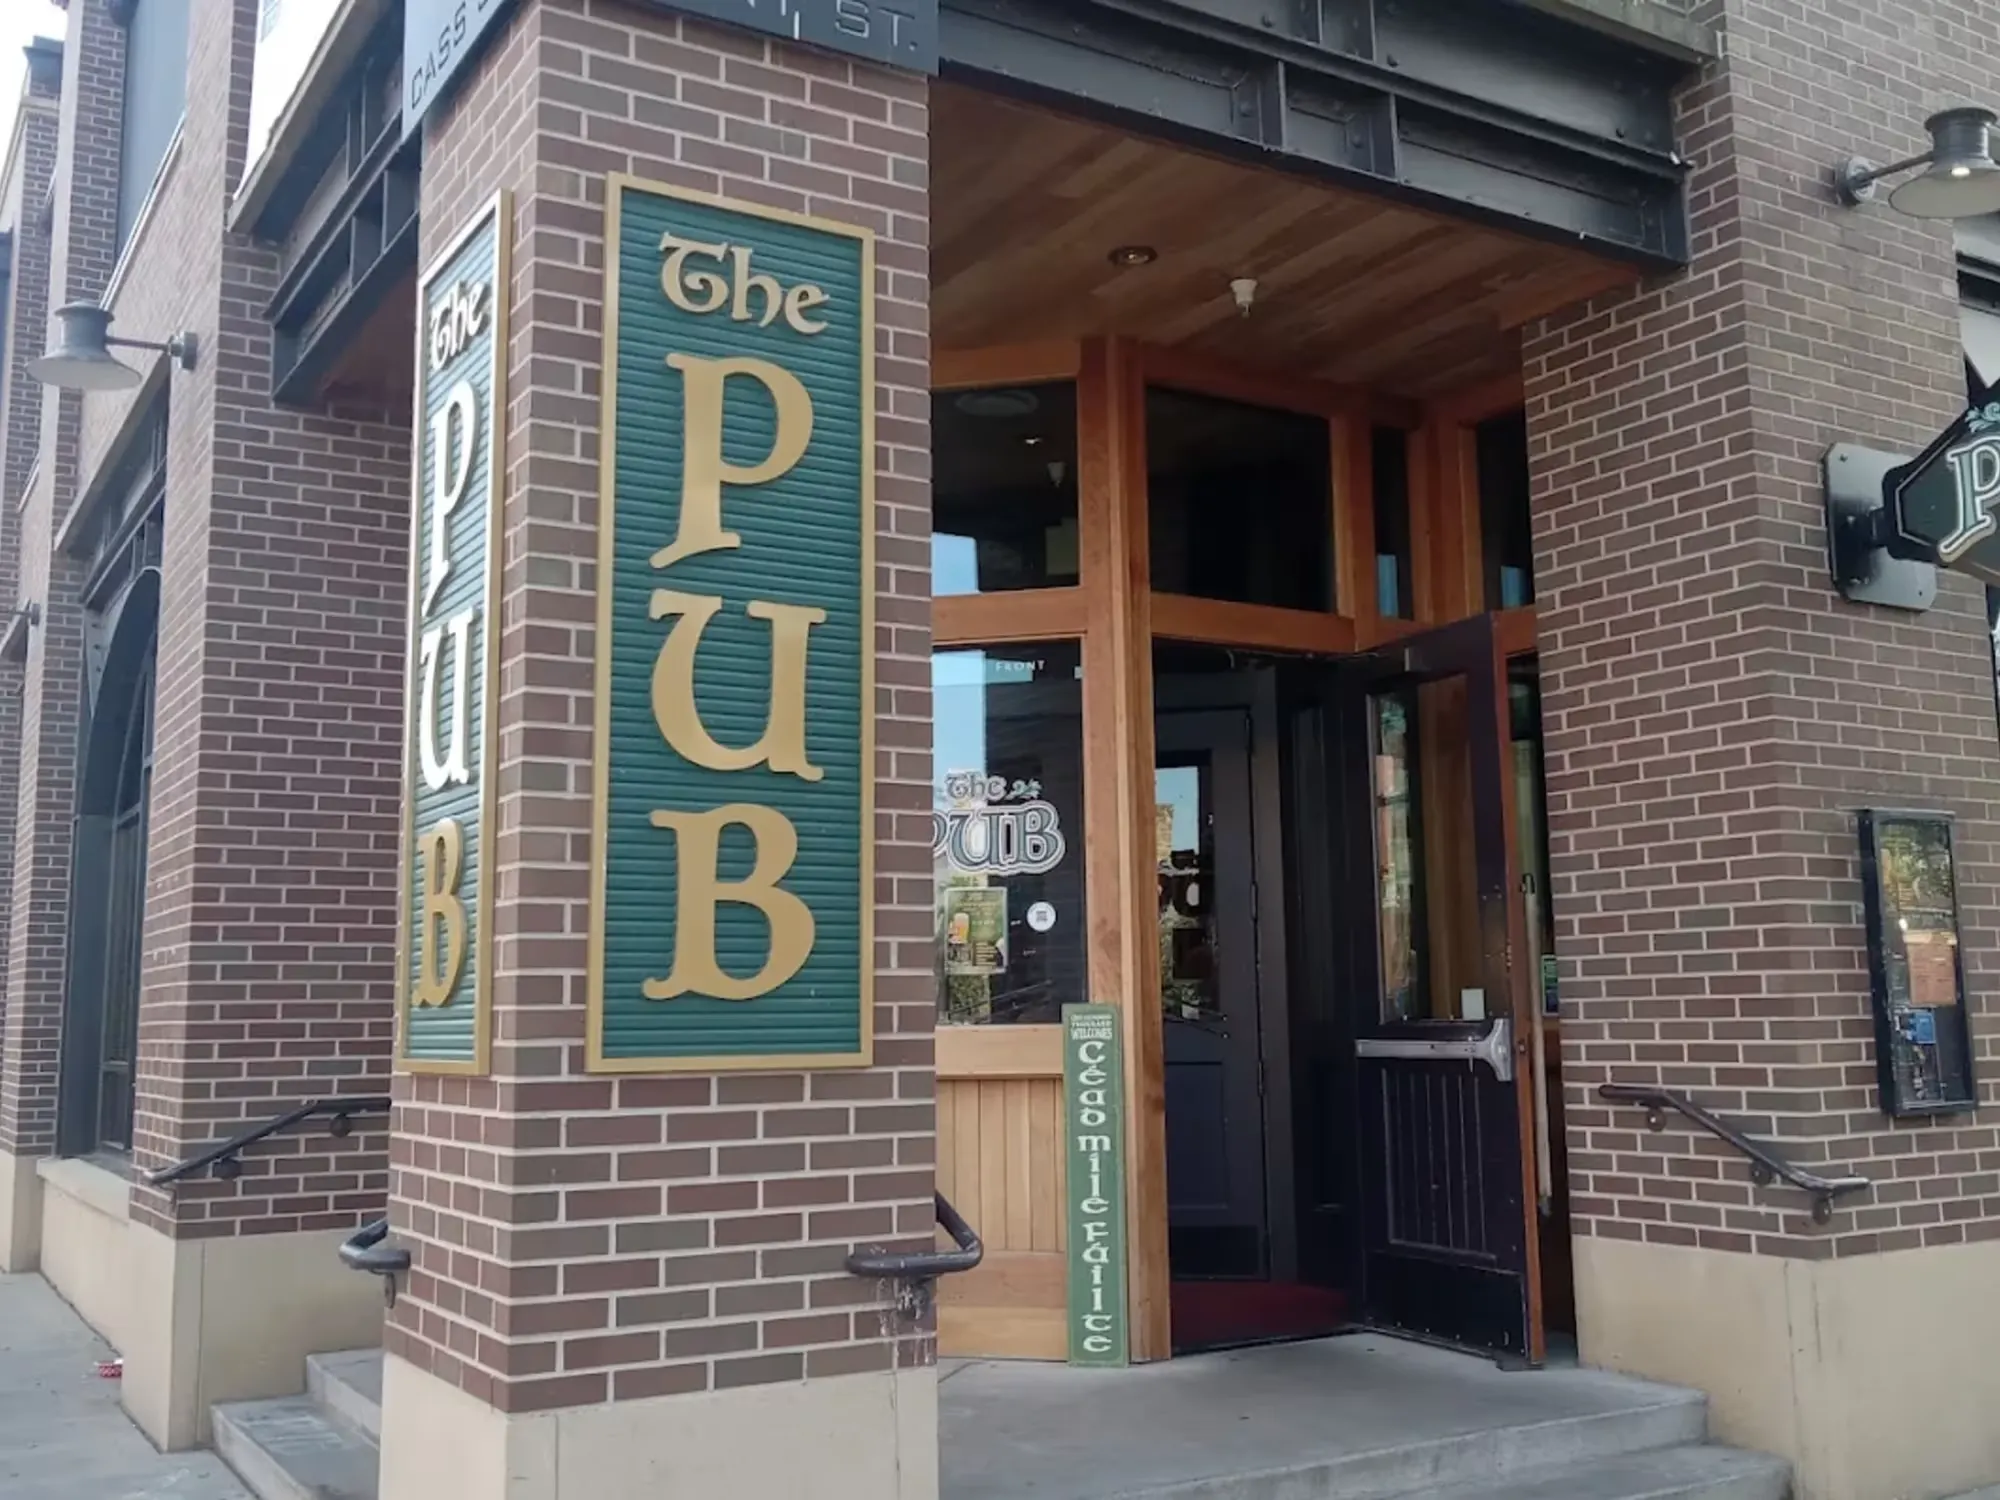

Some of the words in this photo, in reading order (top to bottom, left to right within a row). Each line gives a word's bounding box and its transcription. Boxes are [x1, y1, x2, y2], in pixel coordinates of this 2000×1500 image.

[411, 0, 467, 110] CASS
[834, 0, 918, 51] ST.
[430, 280, 487, 371] The
[659, 231, 831, 335] The
[412, 379, 477, 1008] PUB
[641, 352, 827, 1001] PUB
[995, 659, 1046, 673] FRONT
[945, 770, 1007, 801] The
